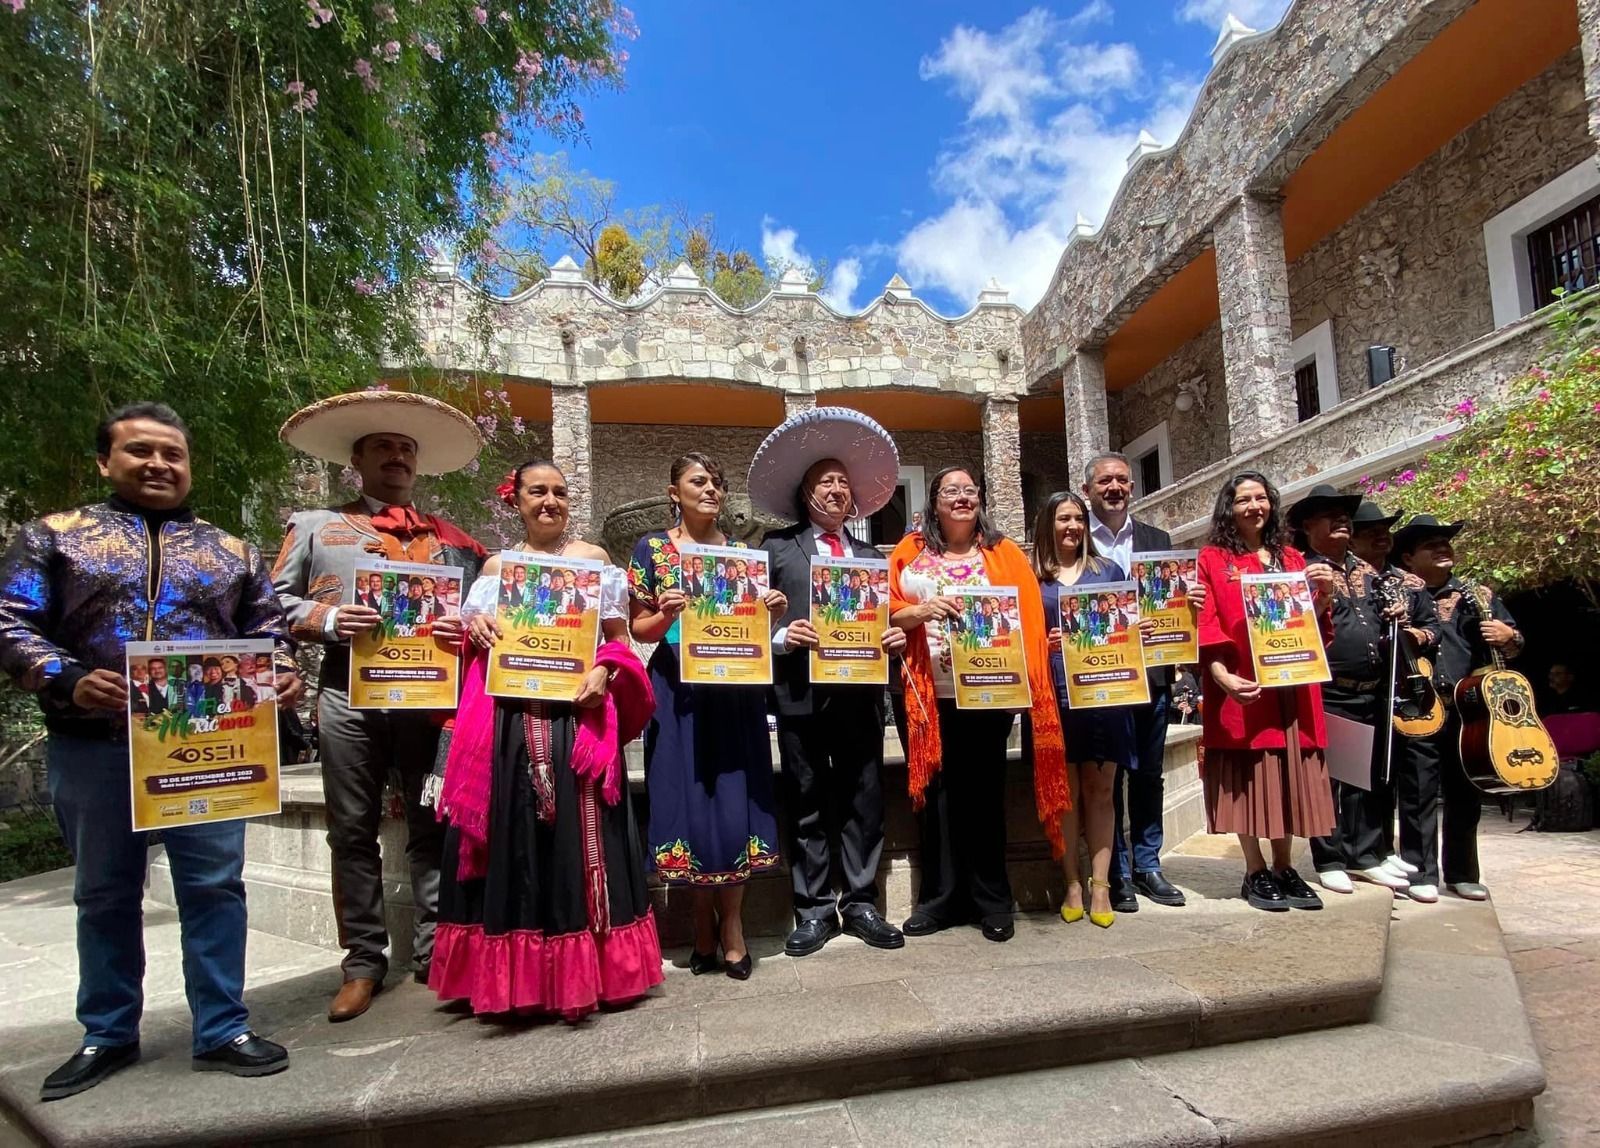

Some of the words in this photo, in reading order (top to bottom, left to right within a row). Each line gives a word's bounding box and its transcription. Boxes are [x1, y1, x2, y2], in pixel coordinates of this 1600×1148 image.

[196, 696, 247, 716] Fiesta
[154, 708, 256, 743] Mexicana
[180, 773, 226, 782] SEPTIEMBRE
